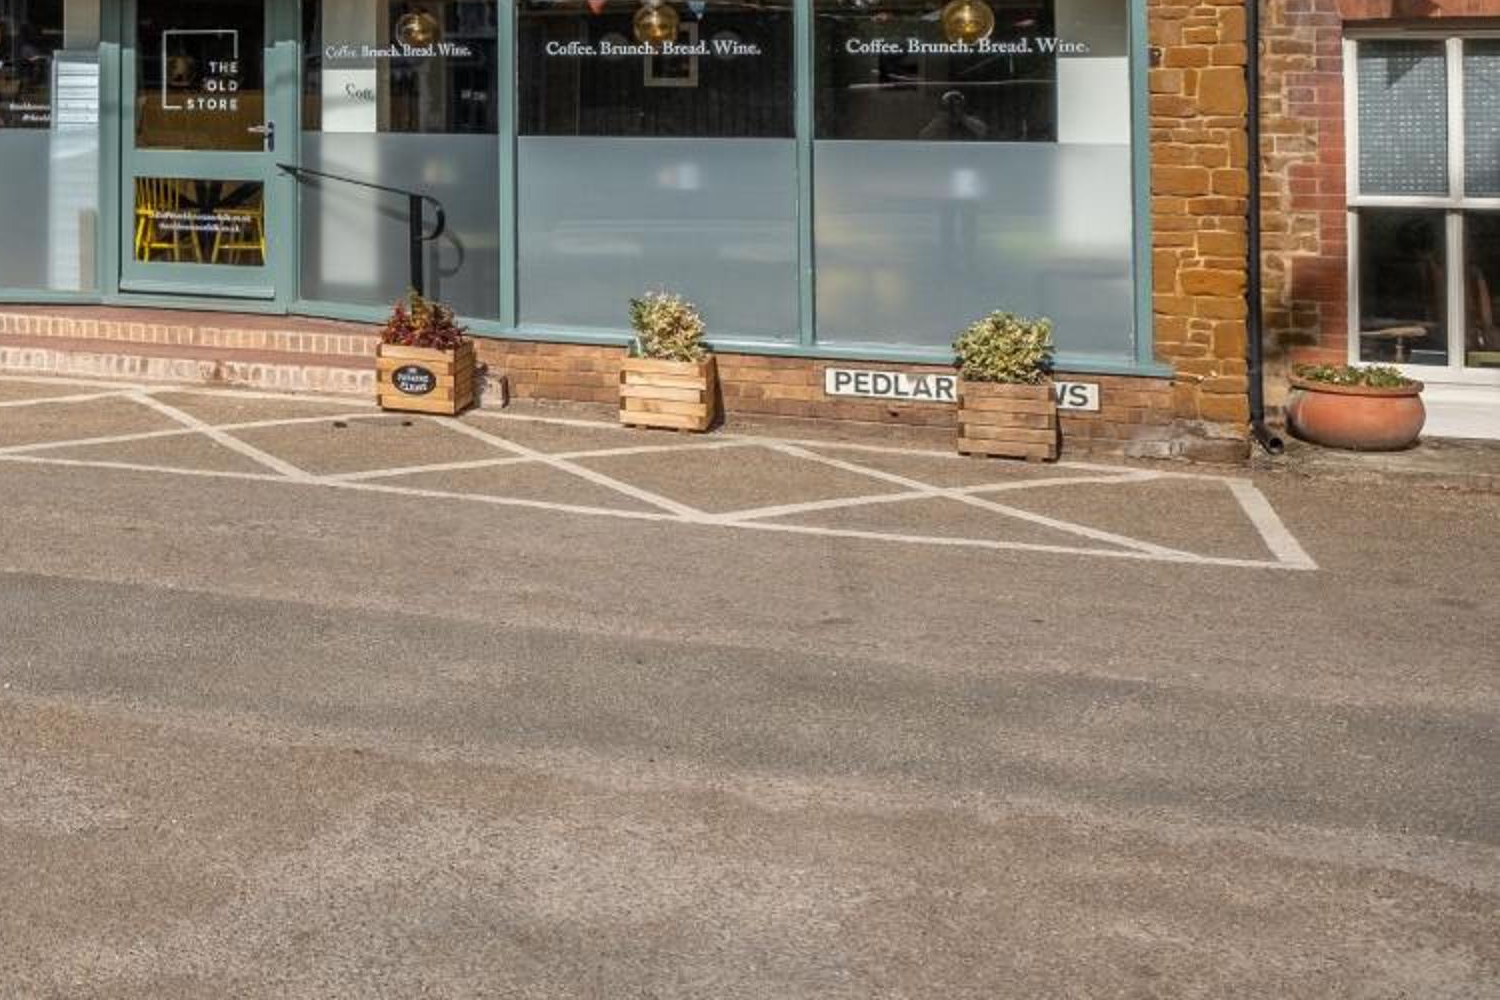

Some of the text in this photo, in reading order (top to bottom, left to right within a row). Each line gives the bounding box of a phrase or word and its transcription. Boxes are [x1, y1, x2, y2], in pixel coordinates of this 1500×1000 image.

[546, 39, 762, 56] Coffee. Brunch. Bread. Wine.
[845, 37, 1091, 54] Coffee. Brunch. Bread. Wine.
[209, 61, 239, 73] THE
[206, 79, 238, 92] OLD
[186, 98, 238, 111] STORE
[834, 371, 955, 399] PEDLAR
